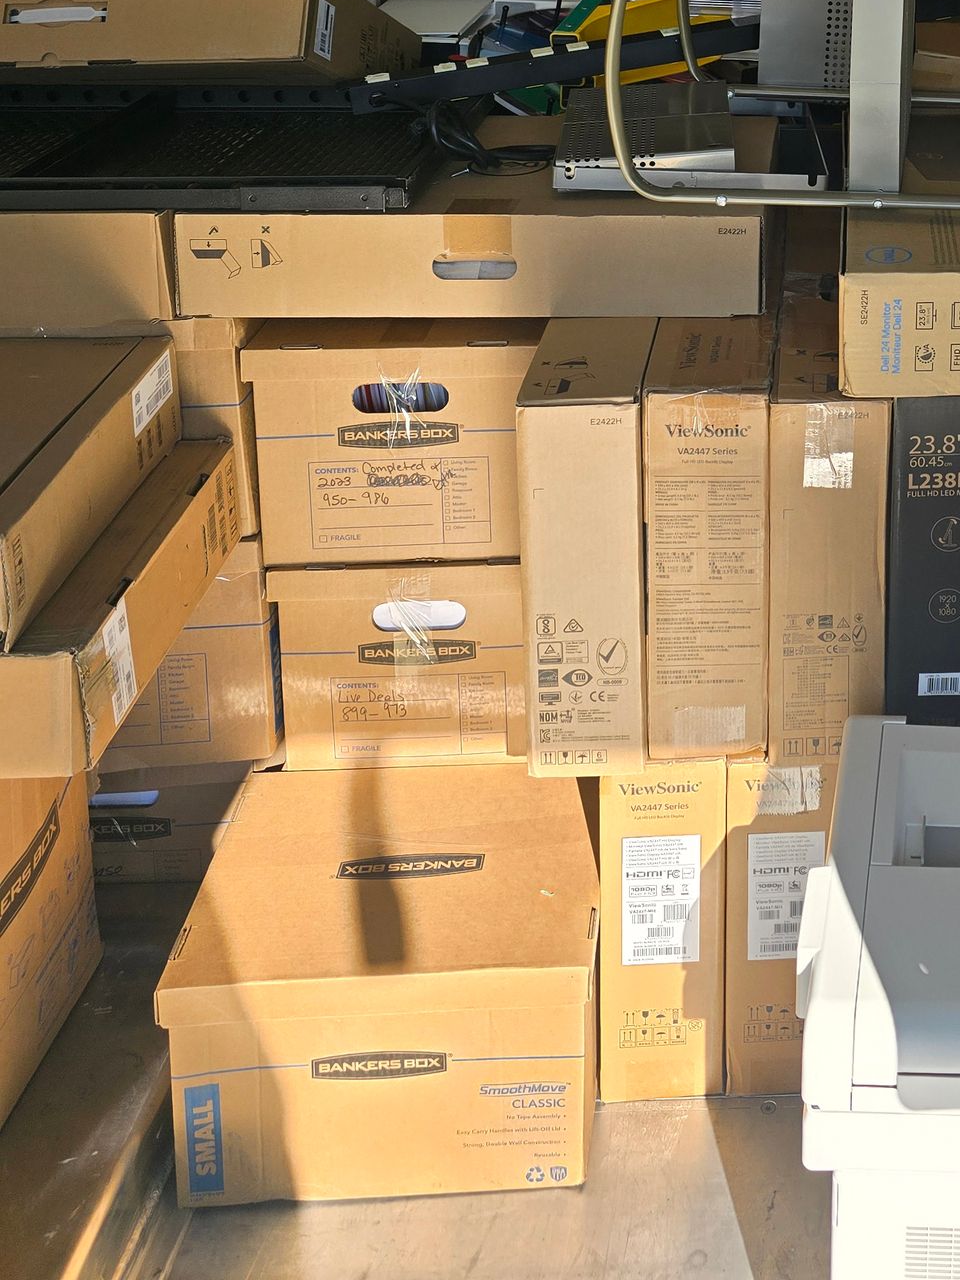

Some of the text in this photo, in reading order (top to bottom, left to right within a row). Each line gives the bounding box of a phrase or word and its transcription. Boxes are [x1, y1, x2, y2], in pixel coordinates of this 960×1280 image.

[860, 289, 869, 325] SE2422H
[881, 302, 891, 372] Dell 24 Monitor
[891, 298, 902, 375] Moniteur Dell 24
[923, 343, 930, 354] VA
[590, 418, 622, 426] E2422H
[344, 428, 454, 441] BANKERS BOX
[665, 424, 748, 438] ViewSonic
[677, 447, 738, 455] VA2447 Series
[315, 467, 359, 475] CONTENTS:
[362, 459, 426, 475] Completed
[317, 476, 351, 488] 2023
[906, 490, 926, 498] FULL
[926, 489, 939, 497] HD
[940, 489, 956, 497] LED
[330, 534, 361, 542] FRAGILE
[939, 595, 957, 604] 1920
[938, 608, 957, 616] 1080
[364, 645, 471, 658] BANKERS BOX
[336, 682, 379, 690] CONTENTS:
[338, 689, 405, 704] Live Deals
[589, 691, 605, 702] CE
[383, 703, 407, 718] 973
[539, 711, 558, 723] NOM
[351, 744, 382, 752] FRAGILE
[618, 781, 699, 796] ViewSonic
[630, 802, 689, 812] VA2447 Series
[133, 823, 166, 833] BOX
[32, 822, 57, 864] BOX
[344, 858, 477, 875] BANKERS BOX
[753, 866, 790, 875] HDMI
[626, 870, 663, 879] HDMI
[318, 1058, 441, 1074] BANKERS BOX
[479, 1083, 567, 1095] SmoothMove
[512, 1098, 566, 1109] CLASSIC
[192, 1099, 217, 1176] SMALL
